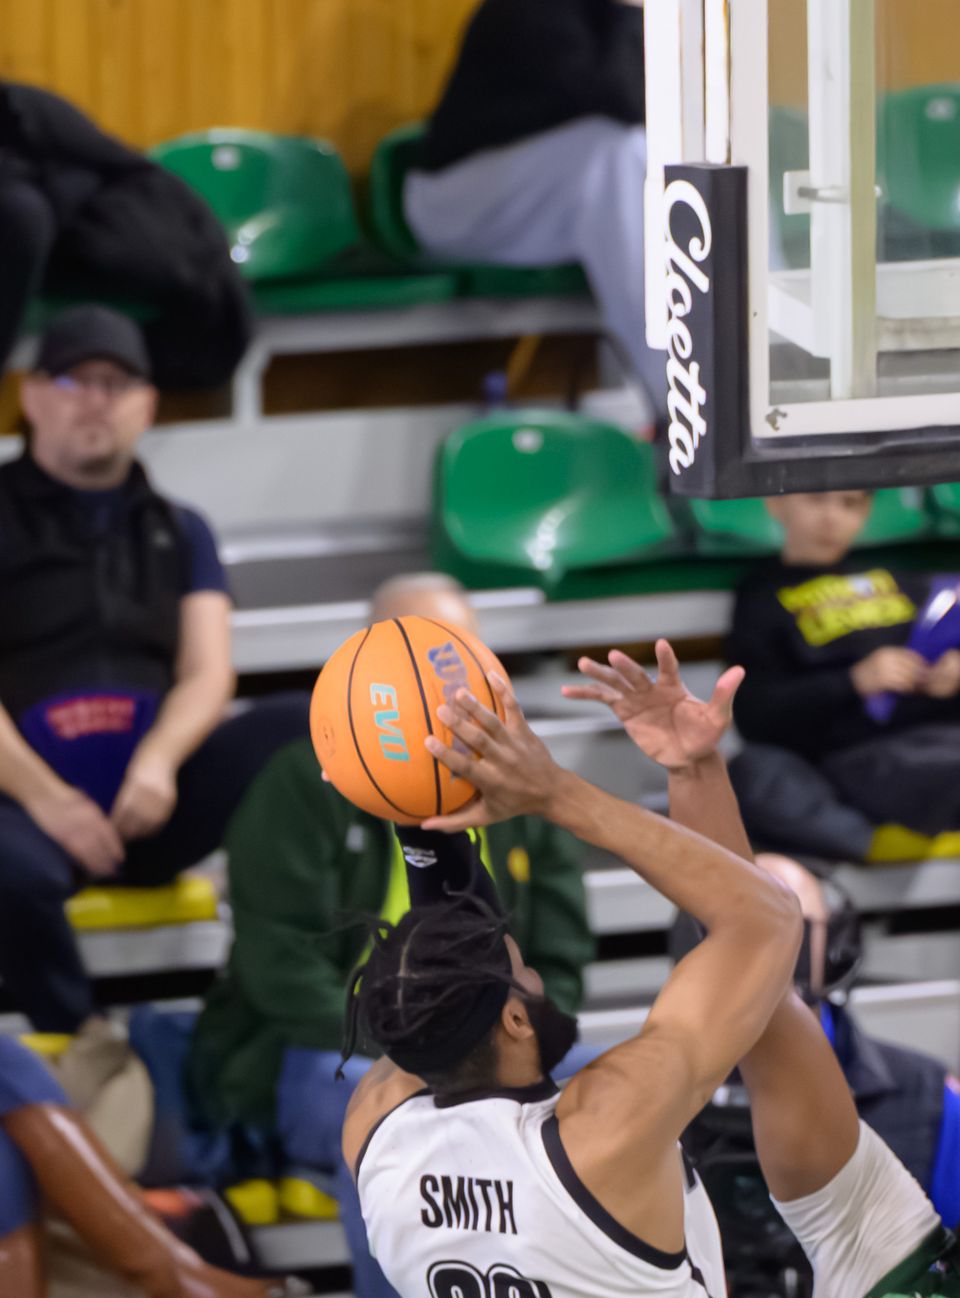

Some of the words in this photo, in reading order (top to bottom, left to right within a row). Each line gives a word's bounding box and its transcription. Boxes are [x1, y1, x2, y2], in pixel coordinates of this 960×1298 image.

[664, 179, 712, 476] Cloetta
[370, 682, 411, 762] EVO
[420, 1174, 518, 1235] SMITH
